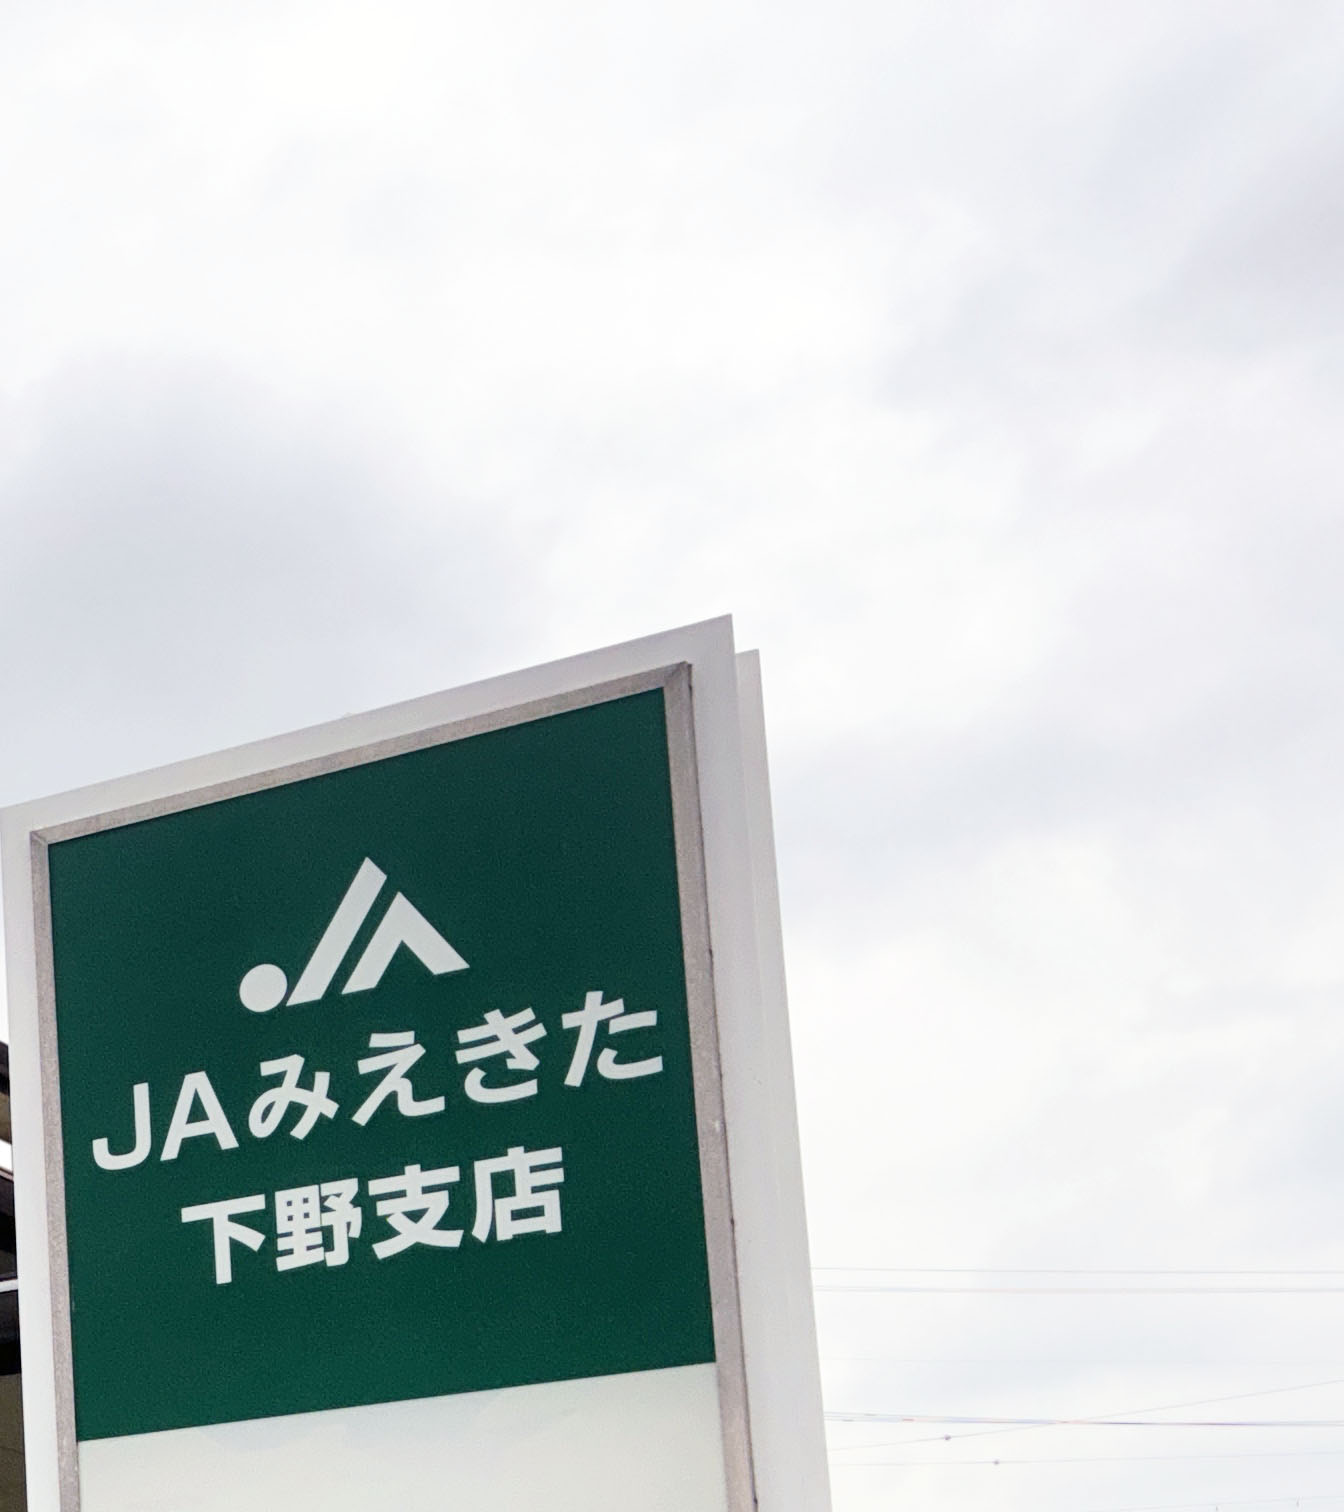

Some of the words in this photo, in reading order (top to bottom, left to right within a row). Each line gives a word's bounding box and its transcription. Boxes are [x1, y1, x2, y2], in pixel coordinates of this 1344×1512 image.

[92, 990, 663, 1170] JAみえきた
[180, 1146, 565, 1285] 下野支店
